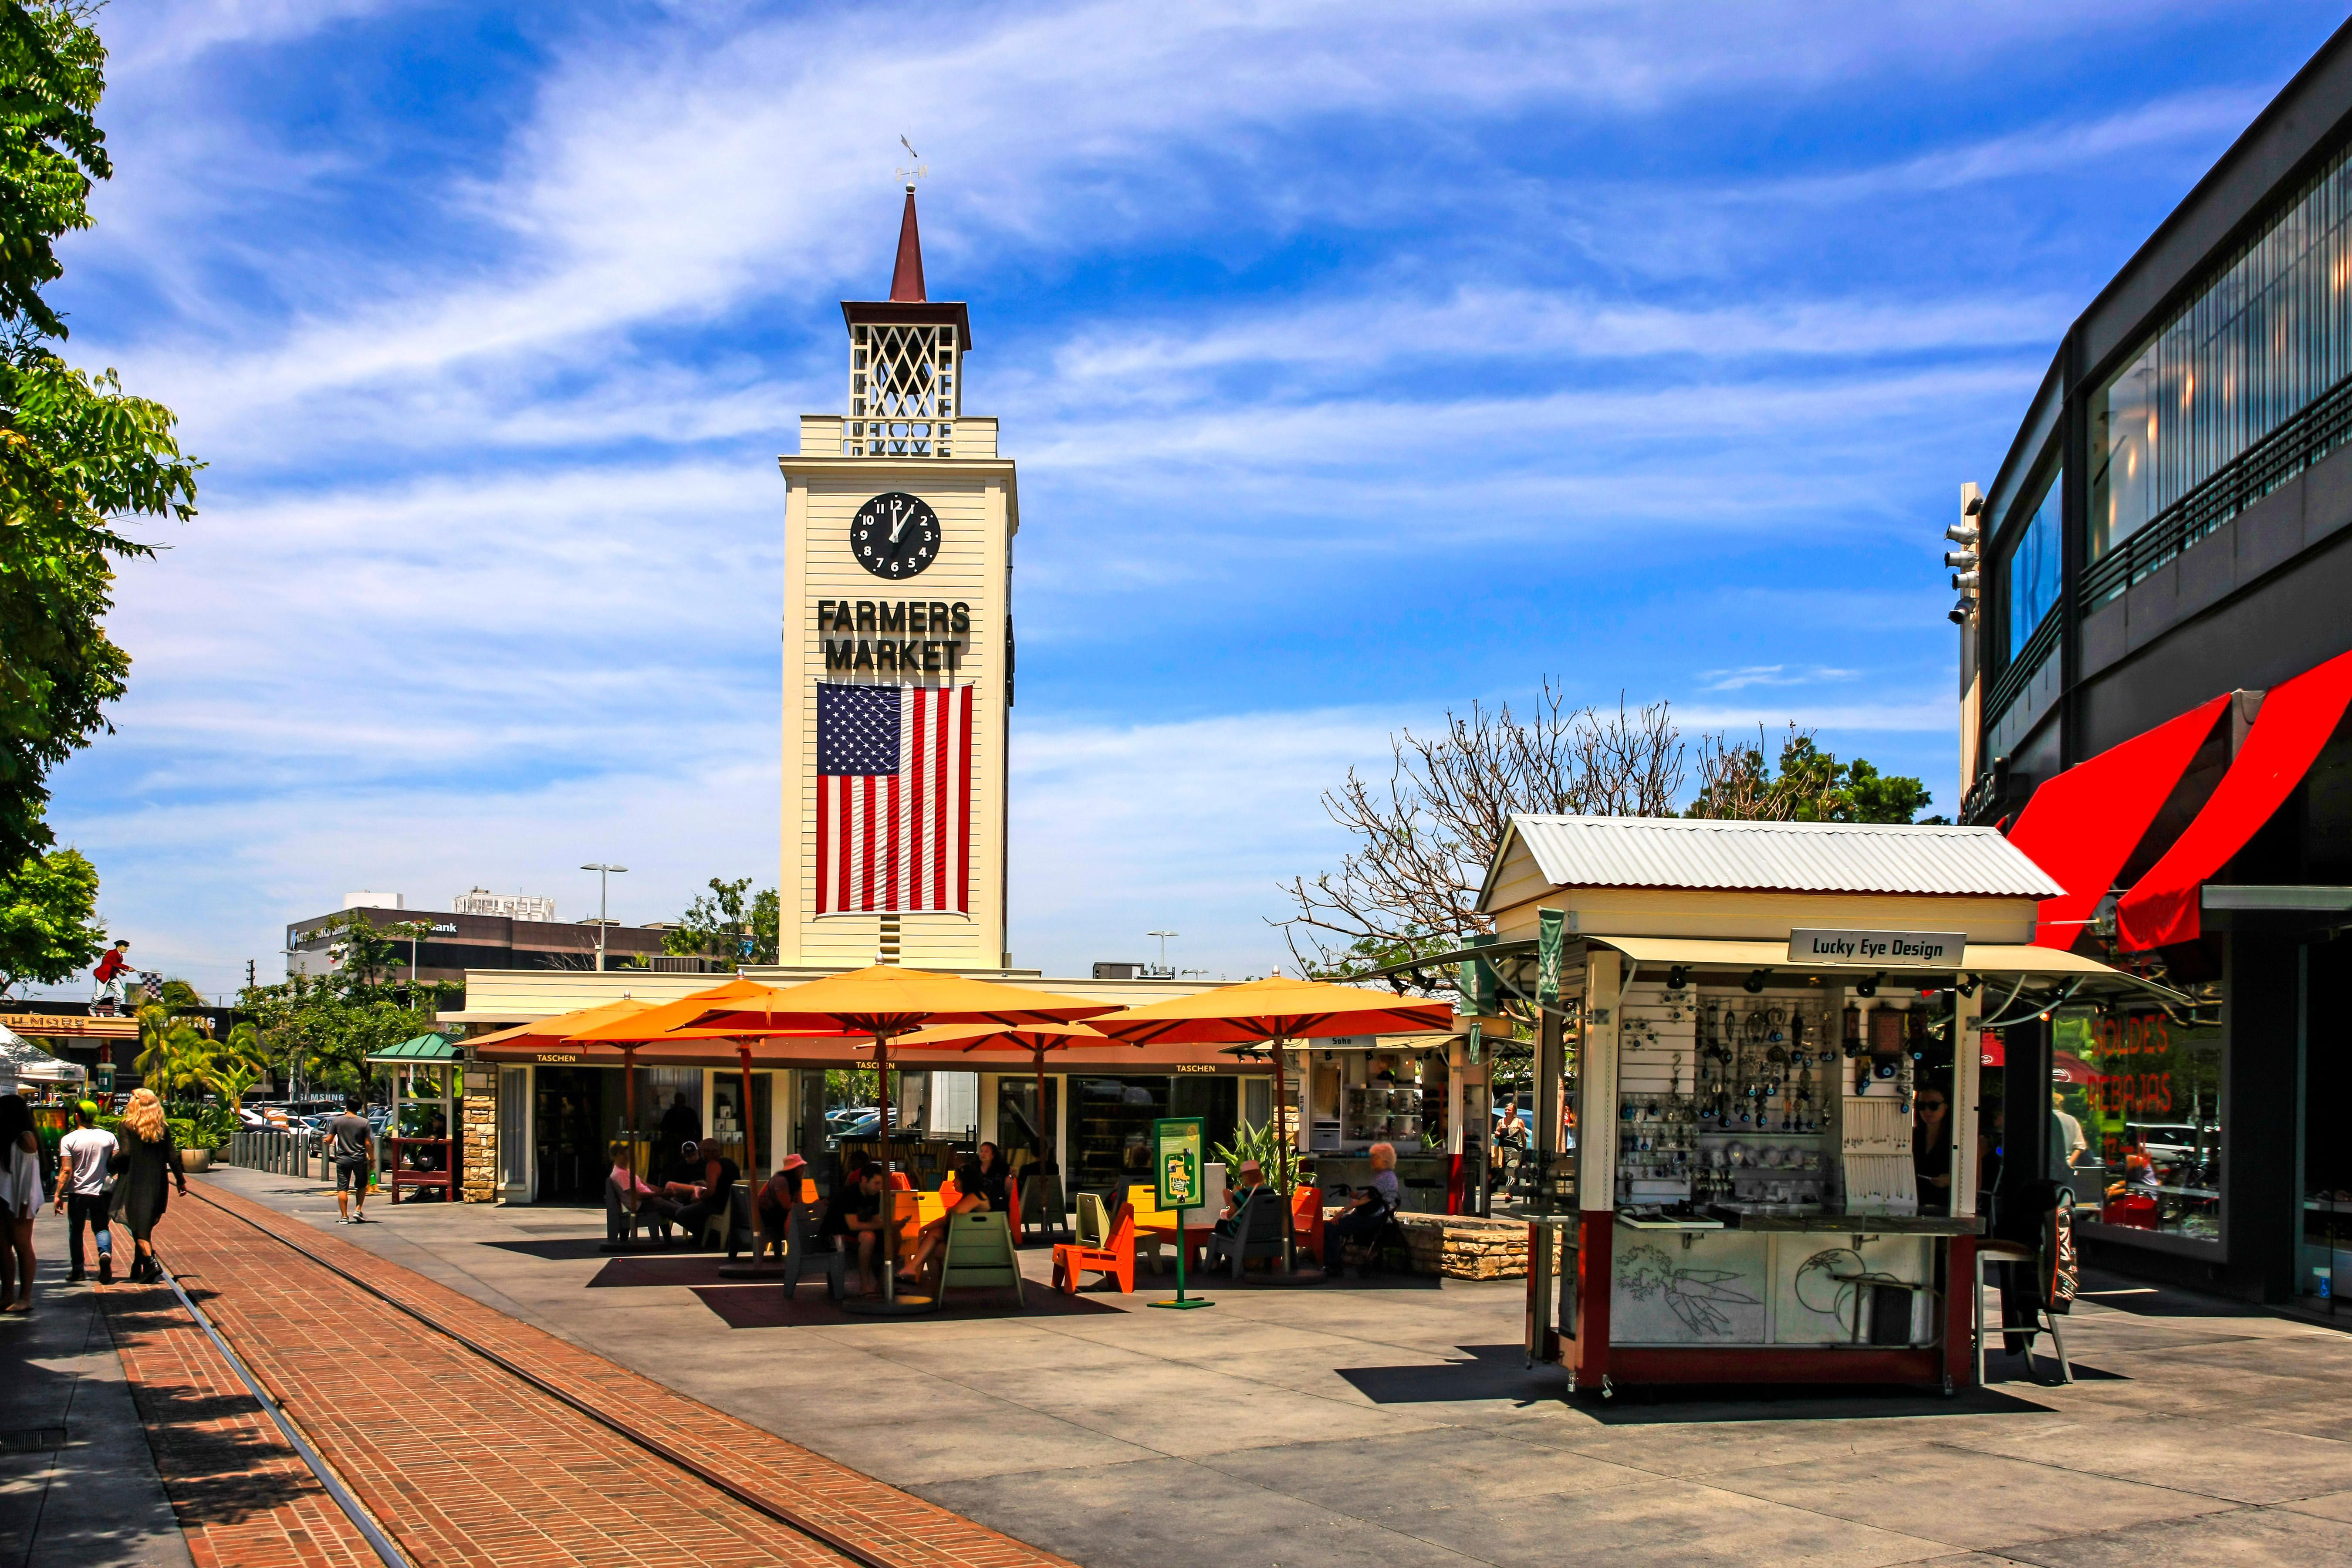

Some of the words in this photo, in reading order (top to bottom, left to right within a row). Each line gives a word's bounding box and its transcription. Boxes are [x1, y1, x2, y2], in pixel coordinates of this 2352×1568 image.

[876, 504, 884, 514] 11
[890, 500, 902, 510] 12
[863, 515, 874, 525] 10
[920, 516, 928, 526] 2
[860, 530, 868, 540] 9
[924, 531, 932, 541] 3
[864, 546, 872, 556] 8
[918, 547, 927, 557] 4
[876, 558, 884, 568] 7
[891, 562, 899, 572] 6
[908, 558, 916, 568] 5
[818, 600, 970, 633] FARMERS
[825, 639, 961, 670] MARKET
[1813, 938, 1855, 957] Lucky
[1860, 939, 1886, 958] Eye
[1892, 939, 1943, 960] Design
[0, 1016, 84, 1026] GILMORE
[2092, 1013, 2168, 1057] SOLDES
[2088, 1073, 2171, 1112] REBAJAS
